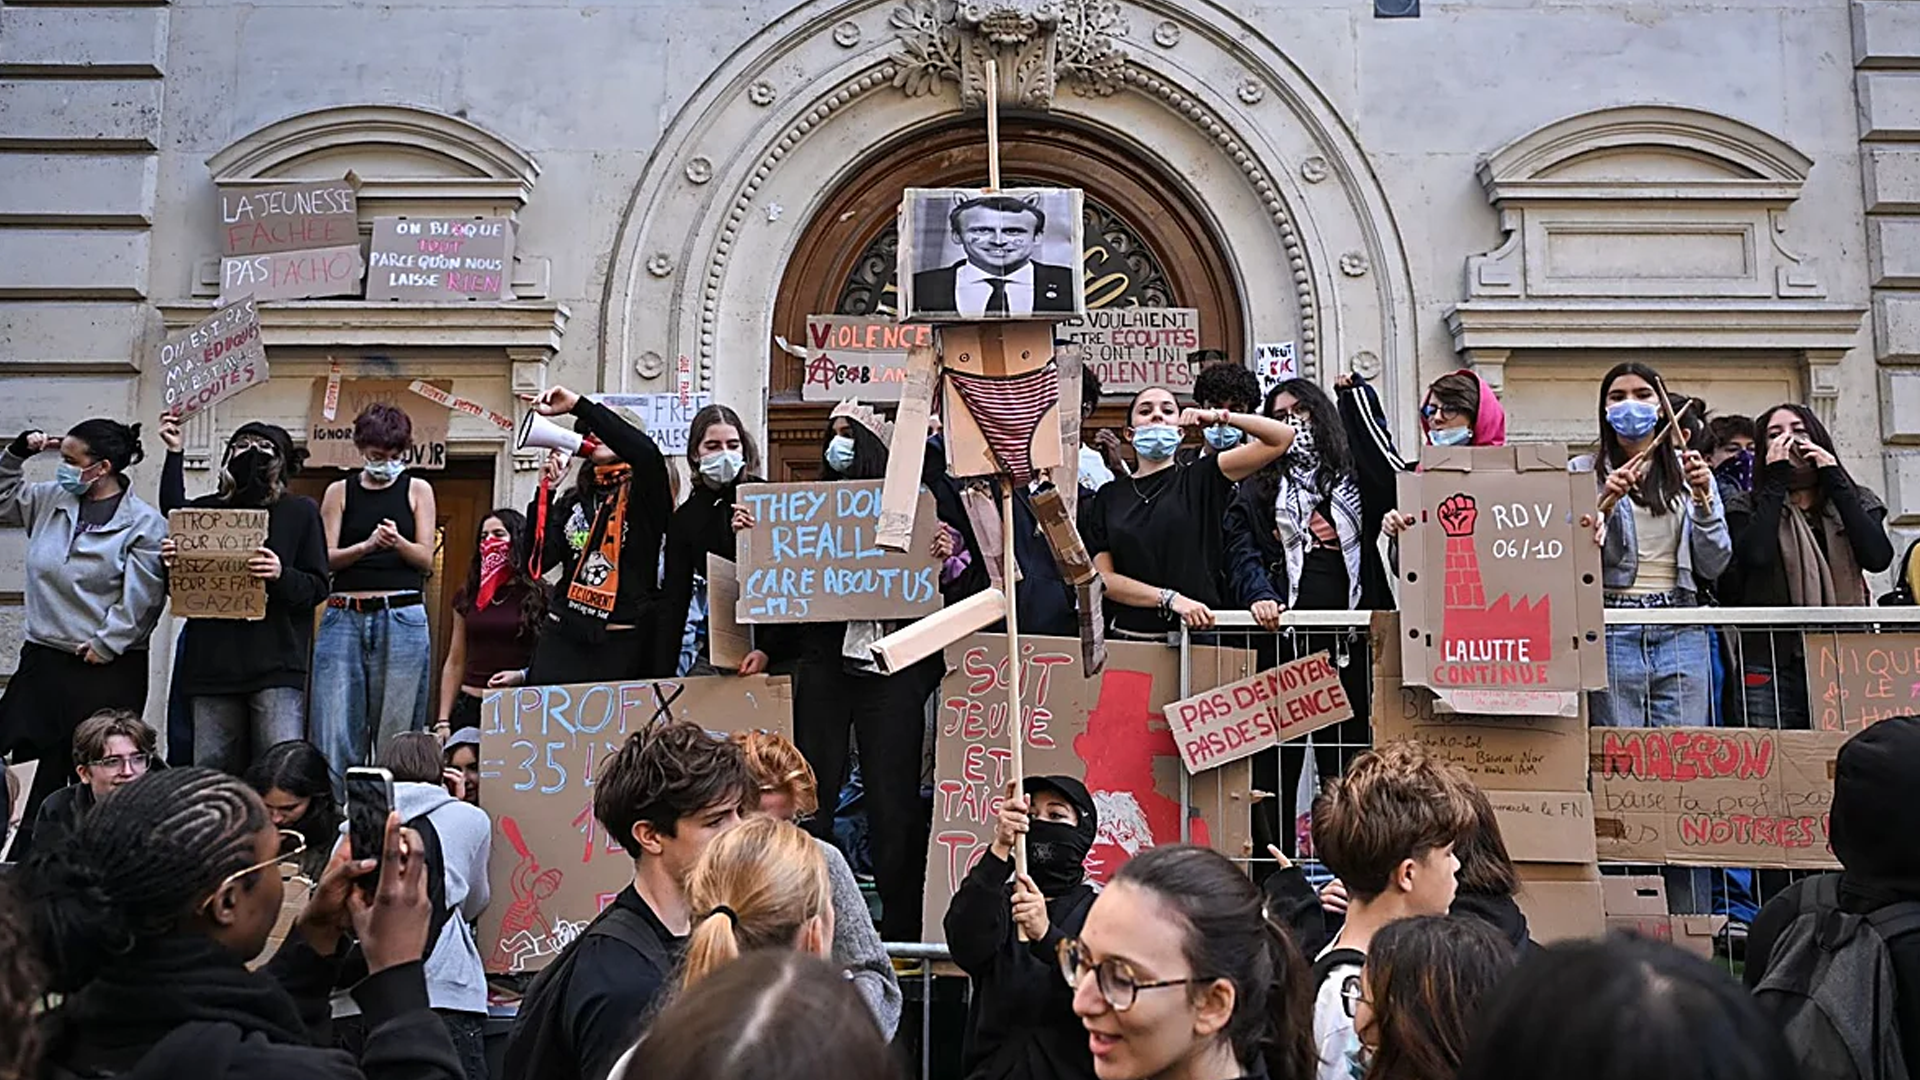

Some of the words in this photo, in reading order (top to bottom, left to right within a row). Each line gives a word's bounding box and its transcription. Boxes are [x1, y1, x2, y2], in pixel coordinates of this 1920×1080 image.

[223, 195, 254, 223] LA
[254, 188, 355, 216] JEUNESSE
[396, 222, 421, 235] ON
[418, 238, 465, 254] TOUT
[225, 256, 270, 289] PAS
[271, 252, 351, 288] FACHO
[370, 252, 415, 268] PARCE
[465, 256, 503, 271] NOUS
[389, 272, 440, 287] LAISSE
[447, 271, 501, 294] RIEN
[1087, 311, 1190, 329] VOULAIENT
[190, 320, 220, 348] EST
[1100, 345, 1135, 361] ONT
[1143, 346, 1181, 364] FINI
[647, 429, 690, 449] PALES
[744, 491, 826, 523] THEY
[1491, 503, 1553, 530] RDV
[174, 511, 222, 530] TROP
[771, 521, 886, 563] REALL
[1492, 539, 1563, 559] 06/10
[172, 576, 206, 592] POUR
[210, 576, 226, 591] SE
[746, 568, 815, 605] CARE
[824, 566, 899, 598] ABOUT
[902, 567, 935, 603] US
[185, 590, 259, 614] GAZER
[1864, 679, 1896, 698] LE
[1179, 693, 1232, 734] PAS
[1232, 680, 1270, 710] DE
[1185, 731, 1227, 766] PAS
[1602, 730, 1775, 782] MACRON
[963, 744, 1013, 788] ET
[1560, 801, 1584, 819] FN
[1604, 784, 1666, 812] baise
[1674, 785, 1702, 811] ta
[1716, 783, 1770, 818] prof
[1783, 789, 1834, 816] pa
